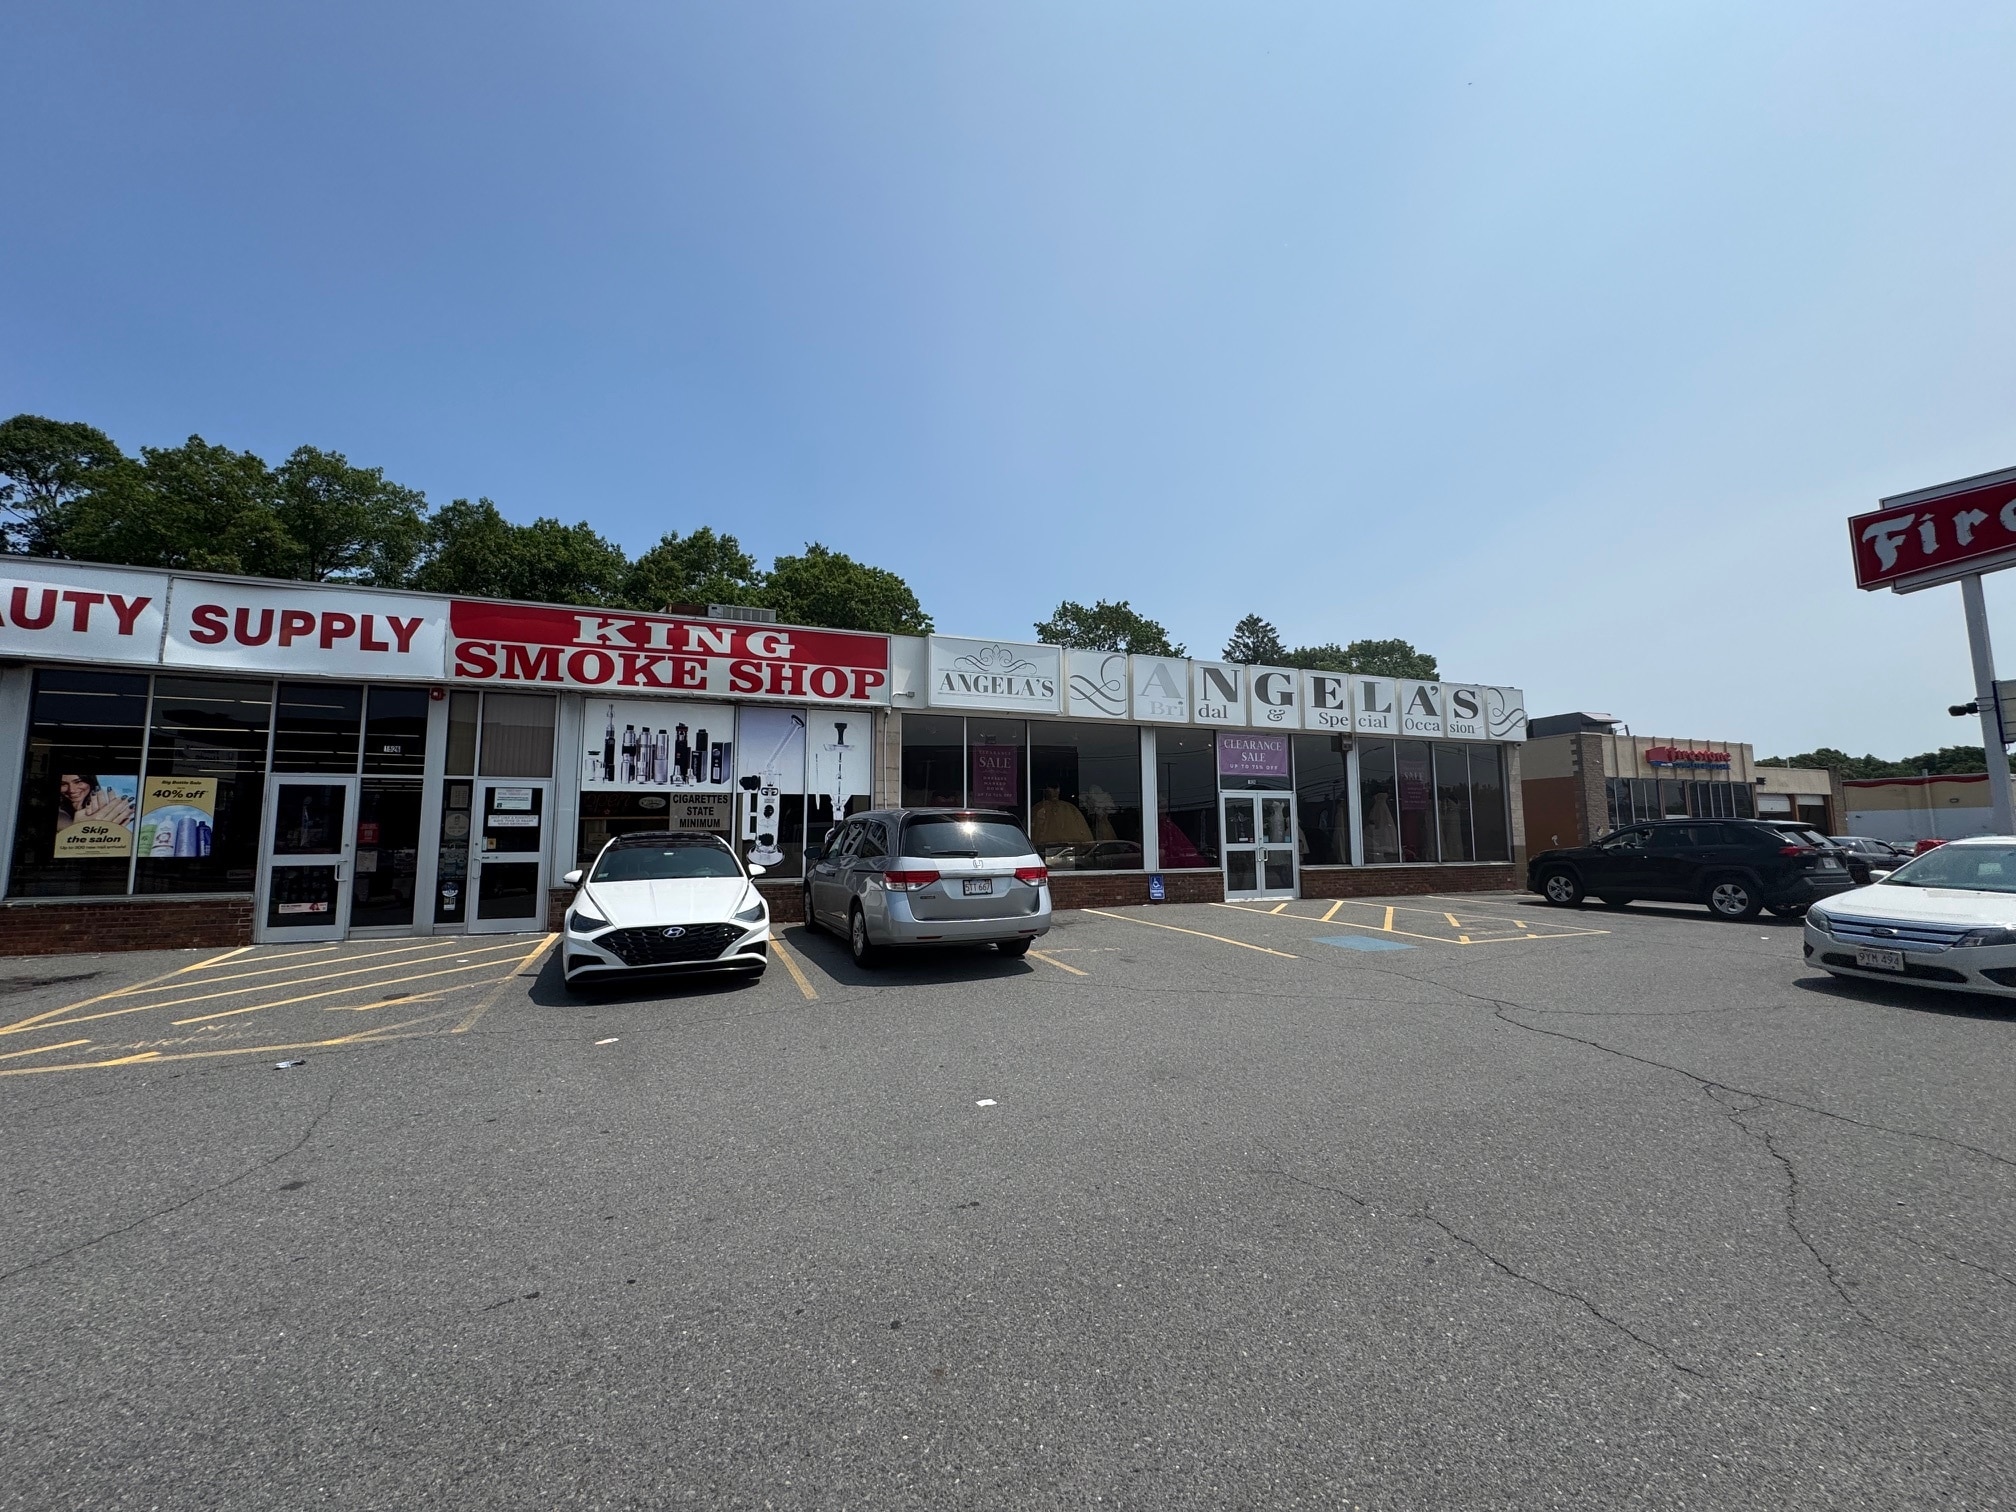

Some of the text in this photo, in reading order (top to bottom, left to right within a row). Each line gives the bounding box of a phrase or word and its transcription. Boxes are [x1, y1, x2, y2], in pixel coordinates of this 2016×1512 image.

[0, 586, 424, 653] UTY SUPPLY
[573, 616, 795, 658] KING
[455, 641, 885, 699] SMOKE SHOP
[938, 672, 1054, 698] ANGELA'S
[1224, 738, 1282, 751] CLEARANCE
[1241, 752, 1266, 762] SALE
[978, 756, 1011, 769] SALE
[152, 789, 183, 798] 40%
[672, 794, 728, 804] CIGARETTES
[686, 806, 714, 816] STATE
[679, 818, 721, 828] MINIMUM
[81, 825, 109, 835] Skip
[67, 835, 121, 844] the salon
